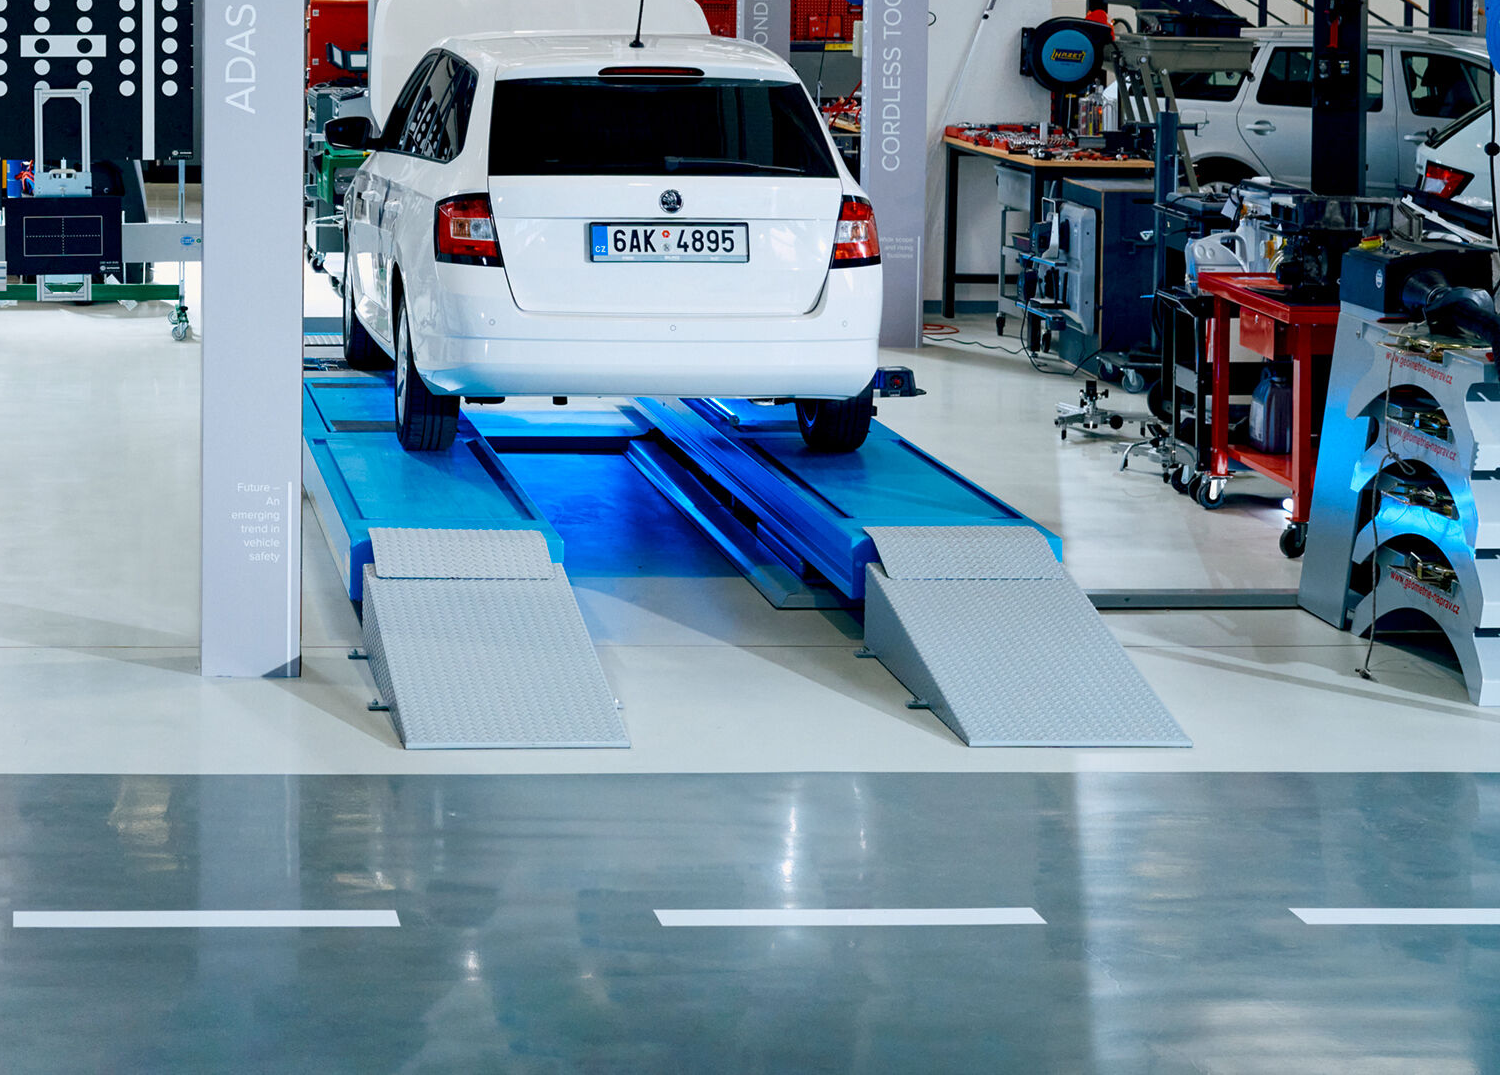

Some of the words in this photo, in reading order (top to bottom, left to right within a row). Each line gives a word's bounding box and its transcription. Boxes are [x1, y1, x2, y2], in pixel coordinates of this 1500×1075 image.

[225, 4, 257, 114] ADAS
[881, 46, 902, 171] CORDLESS
[613, 229, 657, 253] 6AK
[676, 229, 735, 253] 4895
[595, 245, 606, 253] CZ
[237, 482, 270, 492] Future
[265, 496, 280, 506] An
[231, 510, 280, 522] emerging
[241, 524, 268, 533] trend
[270, 524, 280, 533] in
[243, 537, 280, 547] vehicle
[249, 551, 281, 563] safety
